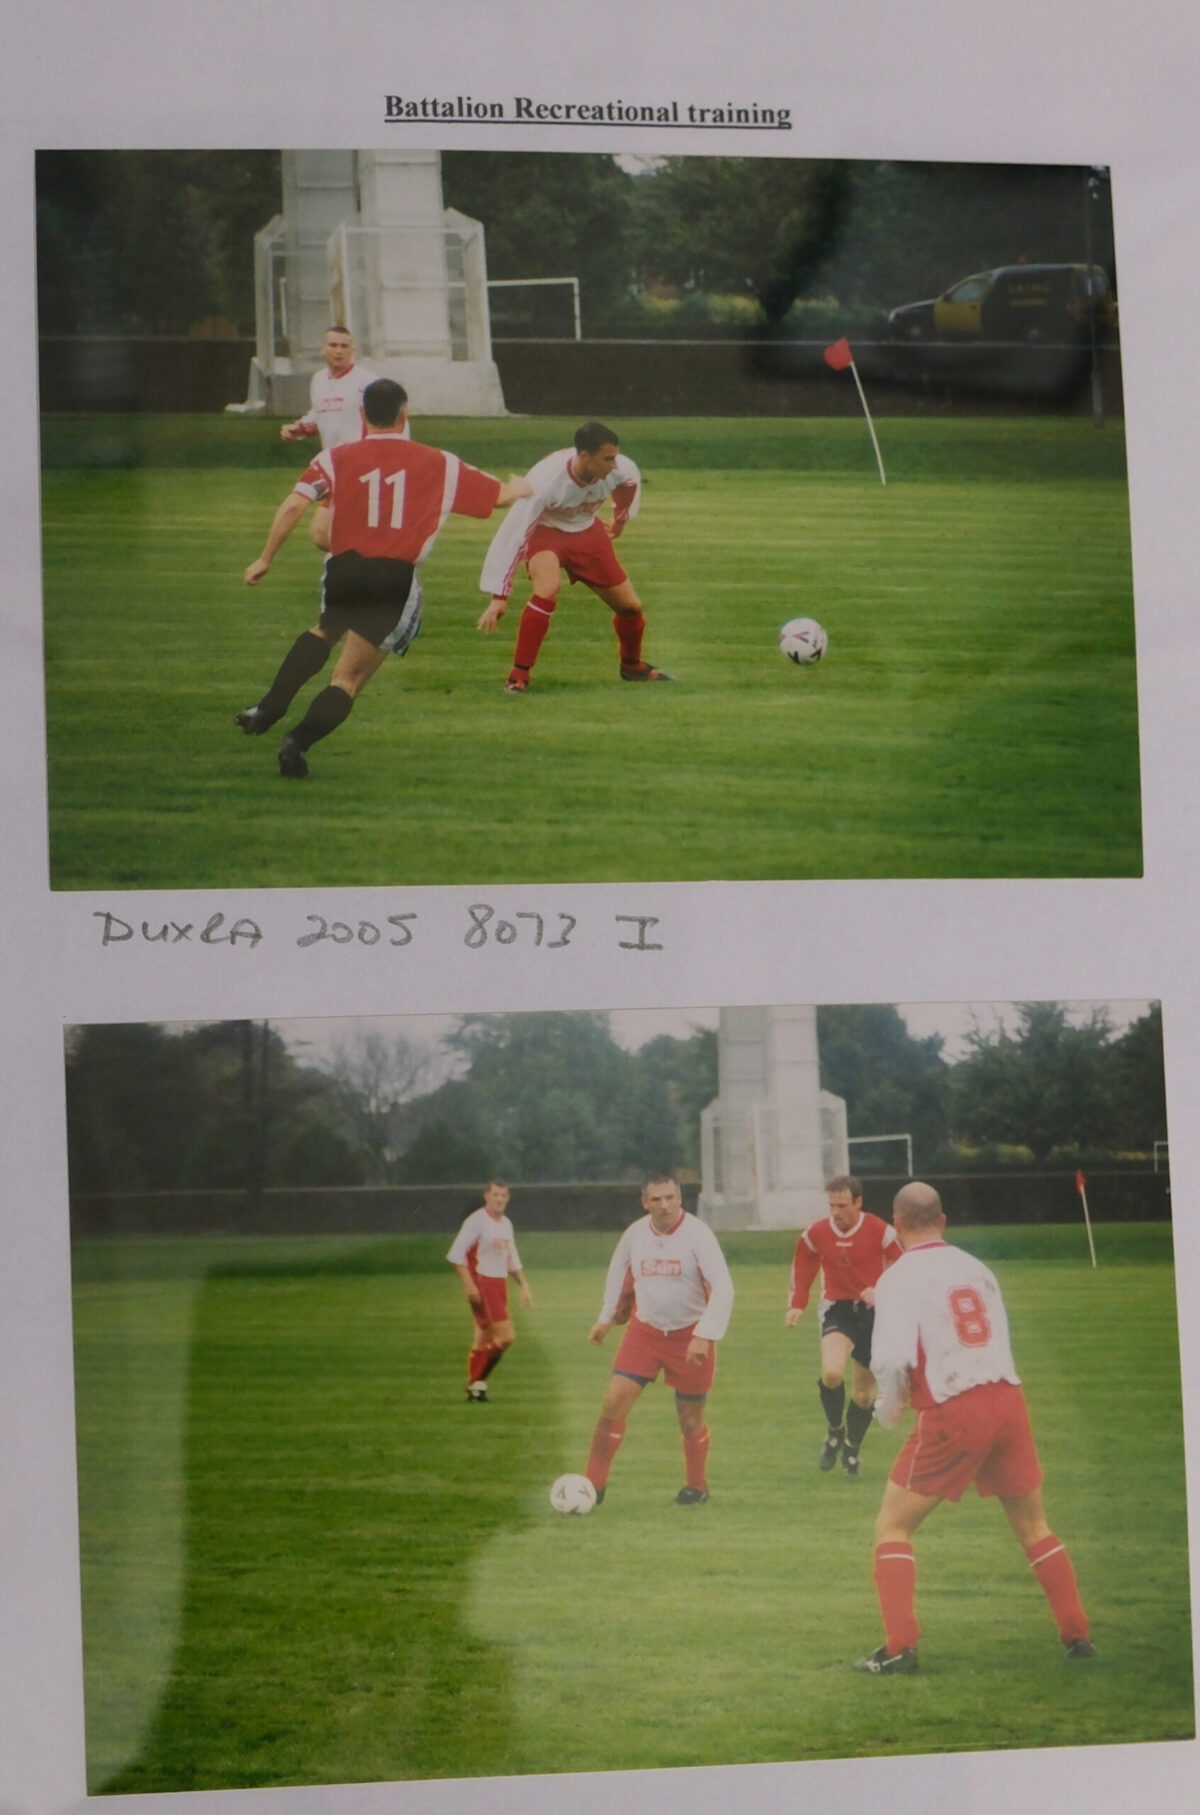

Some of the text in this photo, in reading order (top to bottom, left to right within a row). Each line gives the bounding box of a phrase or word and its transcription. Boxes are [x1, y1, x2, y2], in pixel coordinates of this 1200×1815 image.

[384, 95, 792, 128] Battalion Recreational training
[358, 467, 407, 530] 11
[297, 913, 417, 949] 2005
[463, 903, 576, 949] 8073
[947, 1285, 992, 1348] 8
